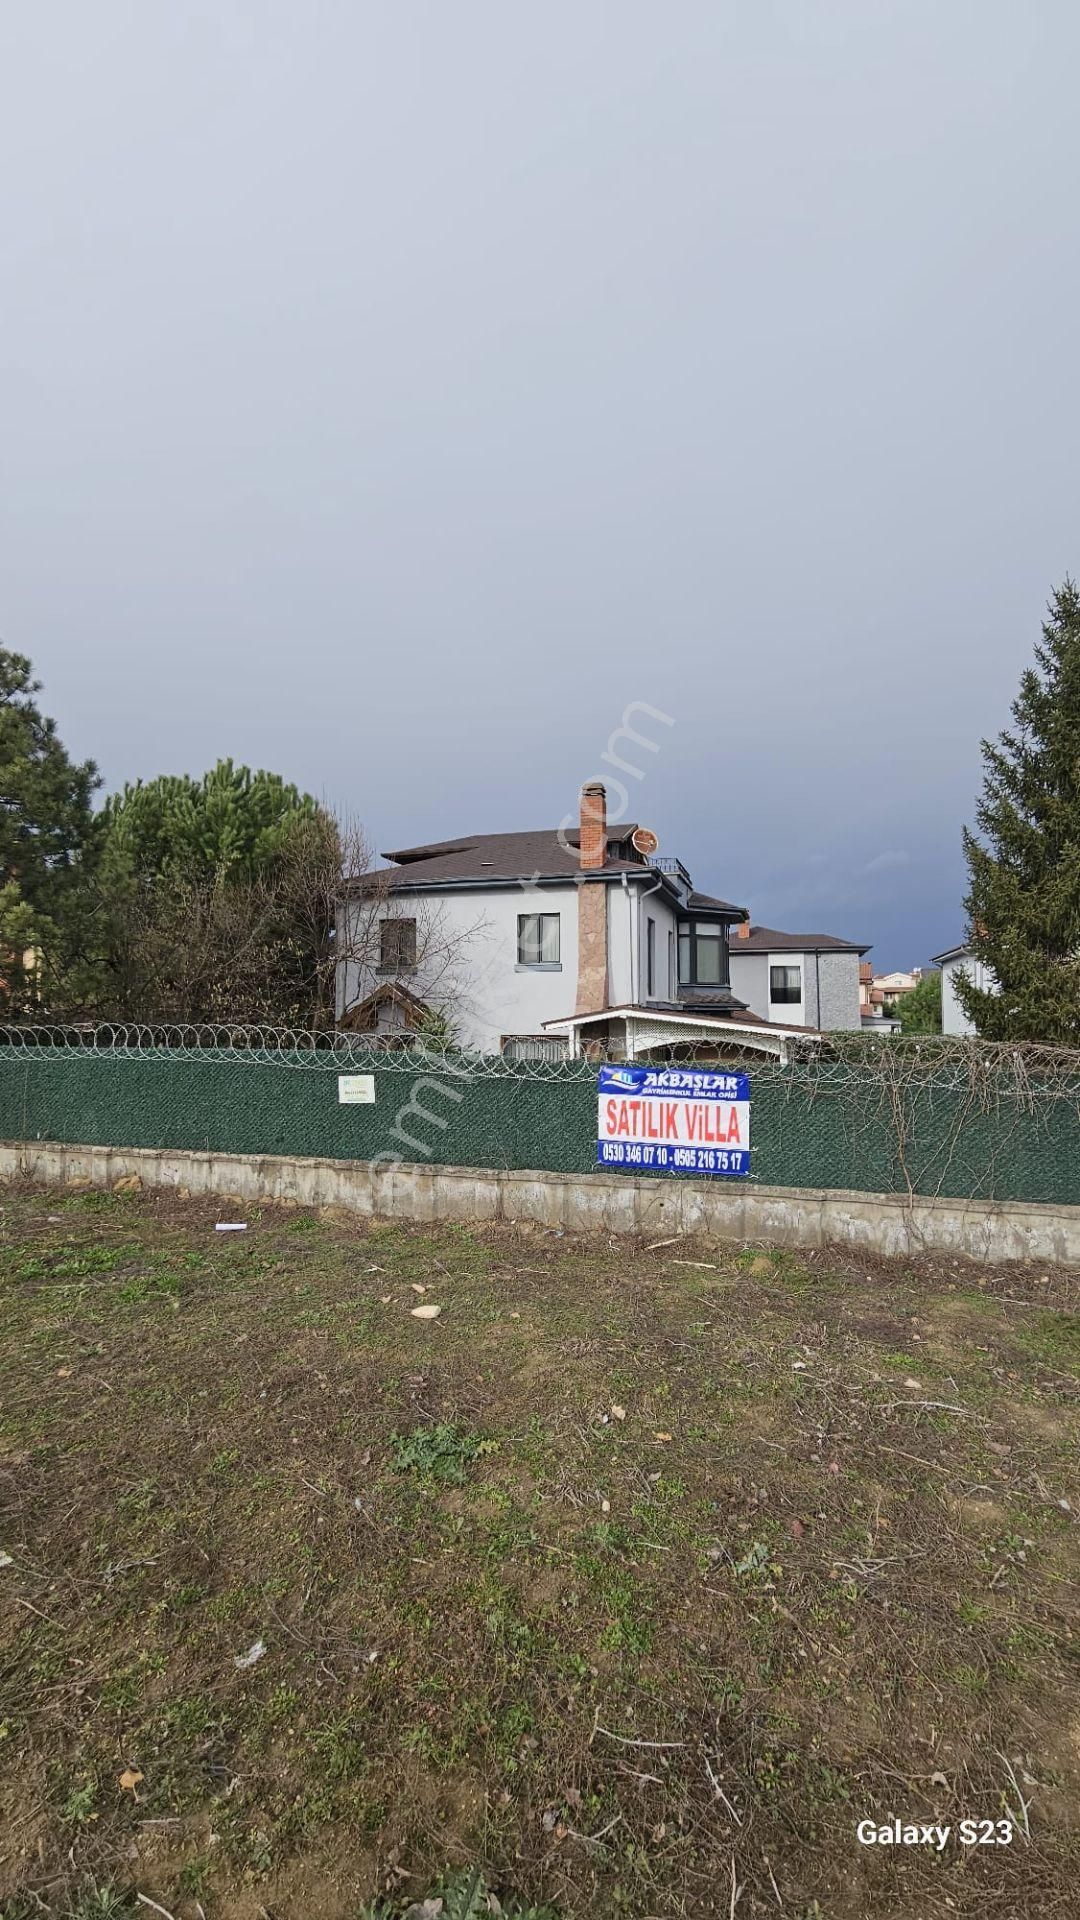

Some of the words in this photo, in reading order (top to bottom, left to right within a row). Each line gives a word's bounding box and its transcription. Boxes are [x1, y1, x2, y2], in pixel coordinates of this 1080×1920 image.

[643, 1072, 738, 1091] AKBAŞLAR
[606, 1098, 679, 1140] SATILIK
[603, 1143, 624, 1162] 0530
[625, 1145, 641, 1163] 346
[643, 1146, 654, 1164] 07
[656, 1147, 668, 1165] 10
[674, 1148, 696, 1167] 0505
[698, 1150, 715, 1169] 216
[716, 1151, 729, 1170] 75
[730, 1152, 742, 1171] 17
